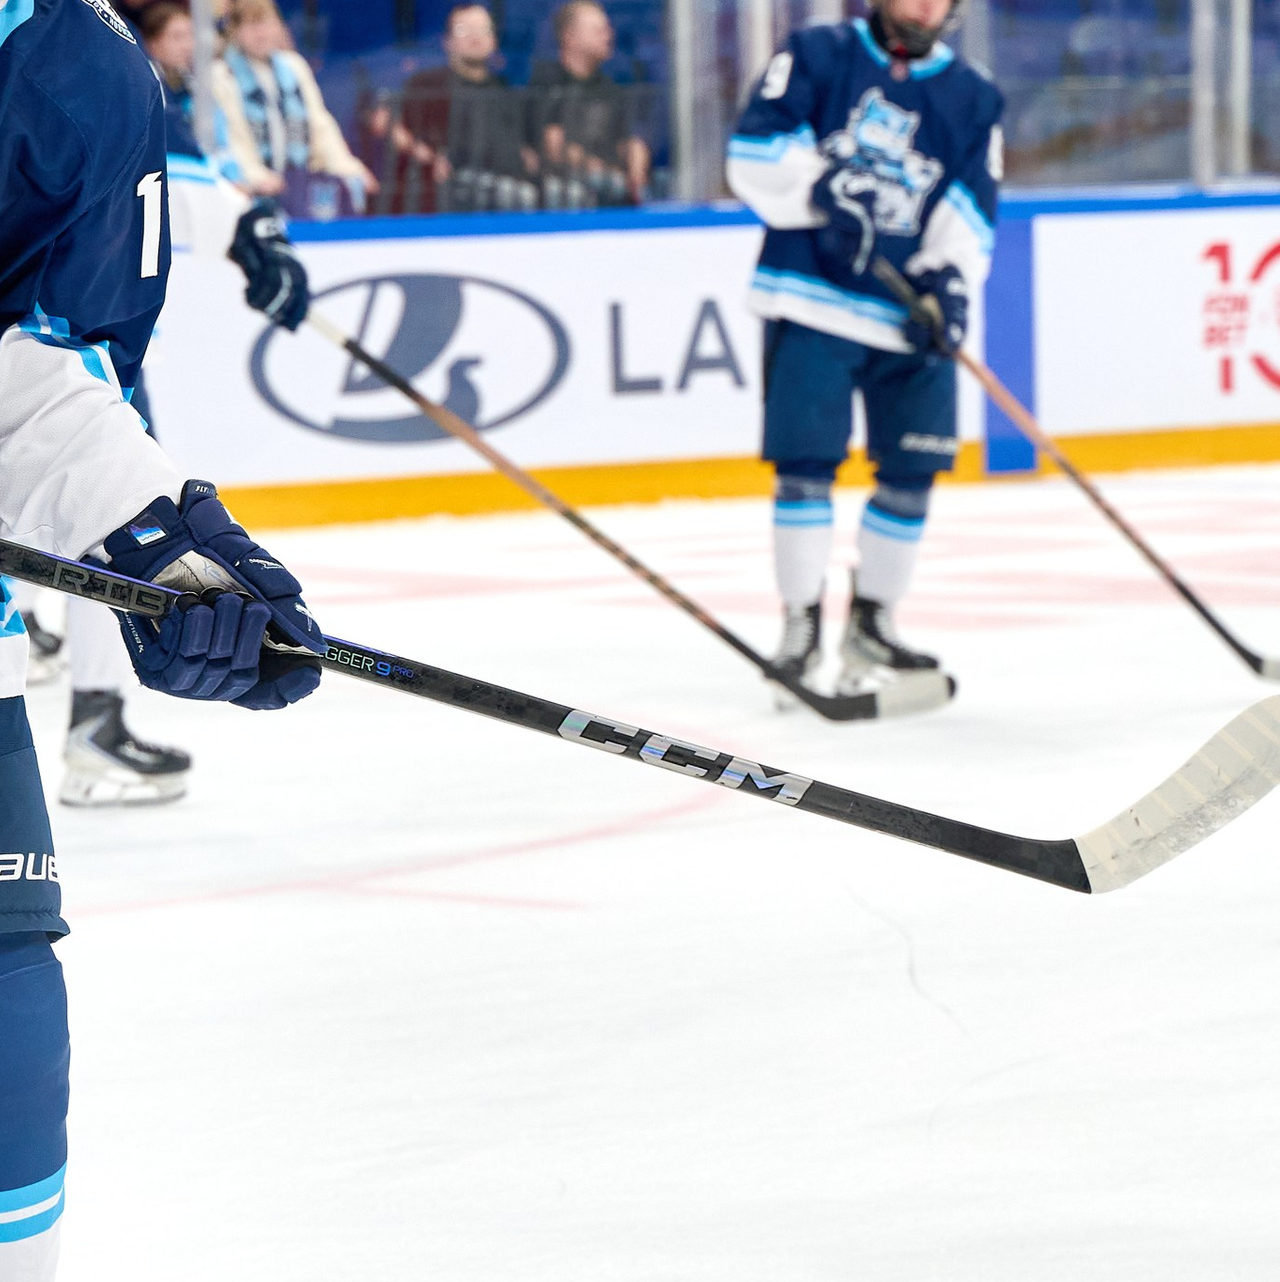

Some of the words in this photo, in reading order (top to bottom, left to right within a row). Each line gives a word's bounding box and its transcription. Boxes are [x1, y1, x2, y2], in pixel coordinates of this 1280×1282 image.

[136, 170, 163, 279] 1
[322, 645, 375, 672] GGER
[376, 661, 392, 677] 9
[392, 664, 415, 679] PRO
[557, 709, 814, 806] CCM
